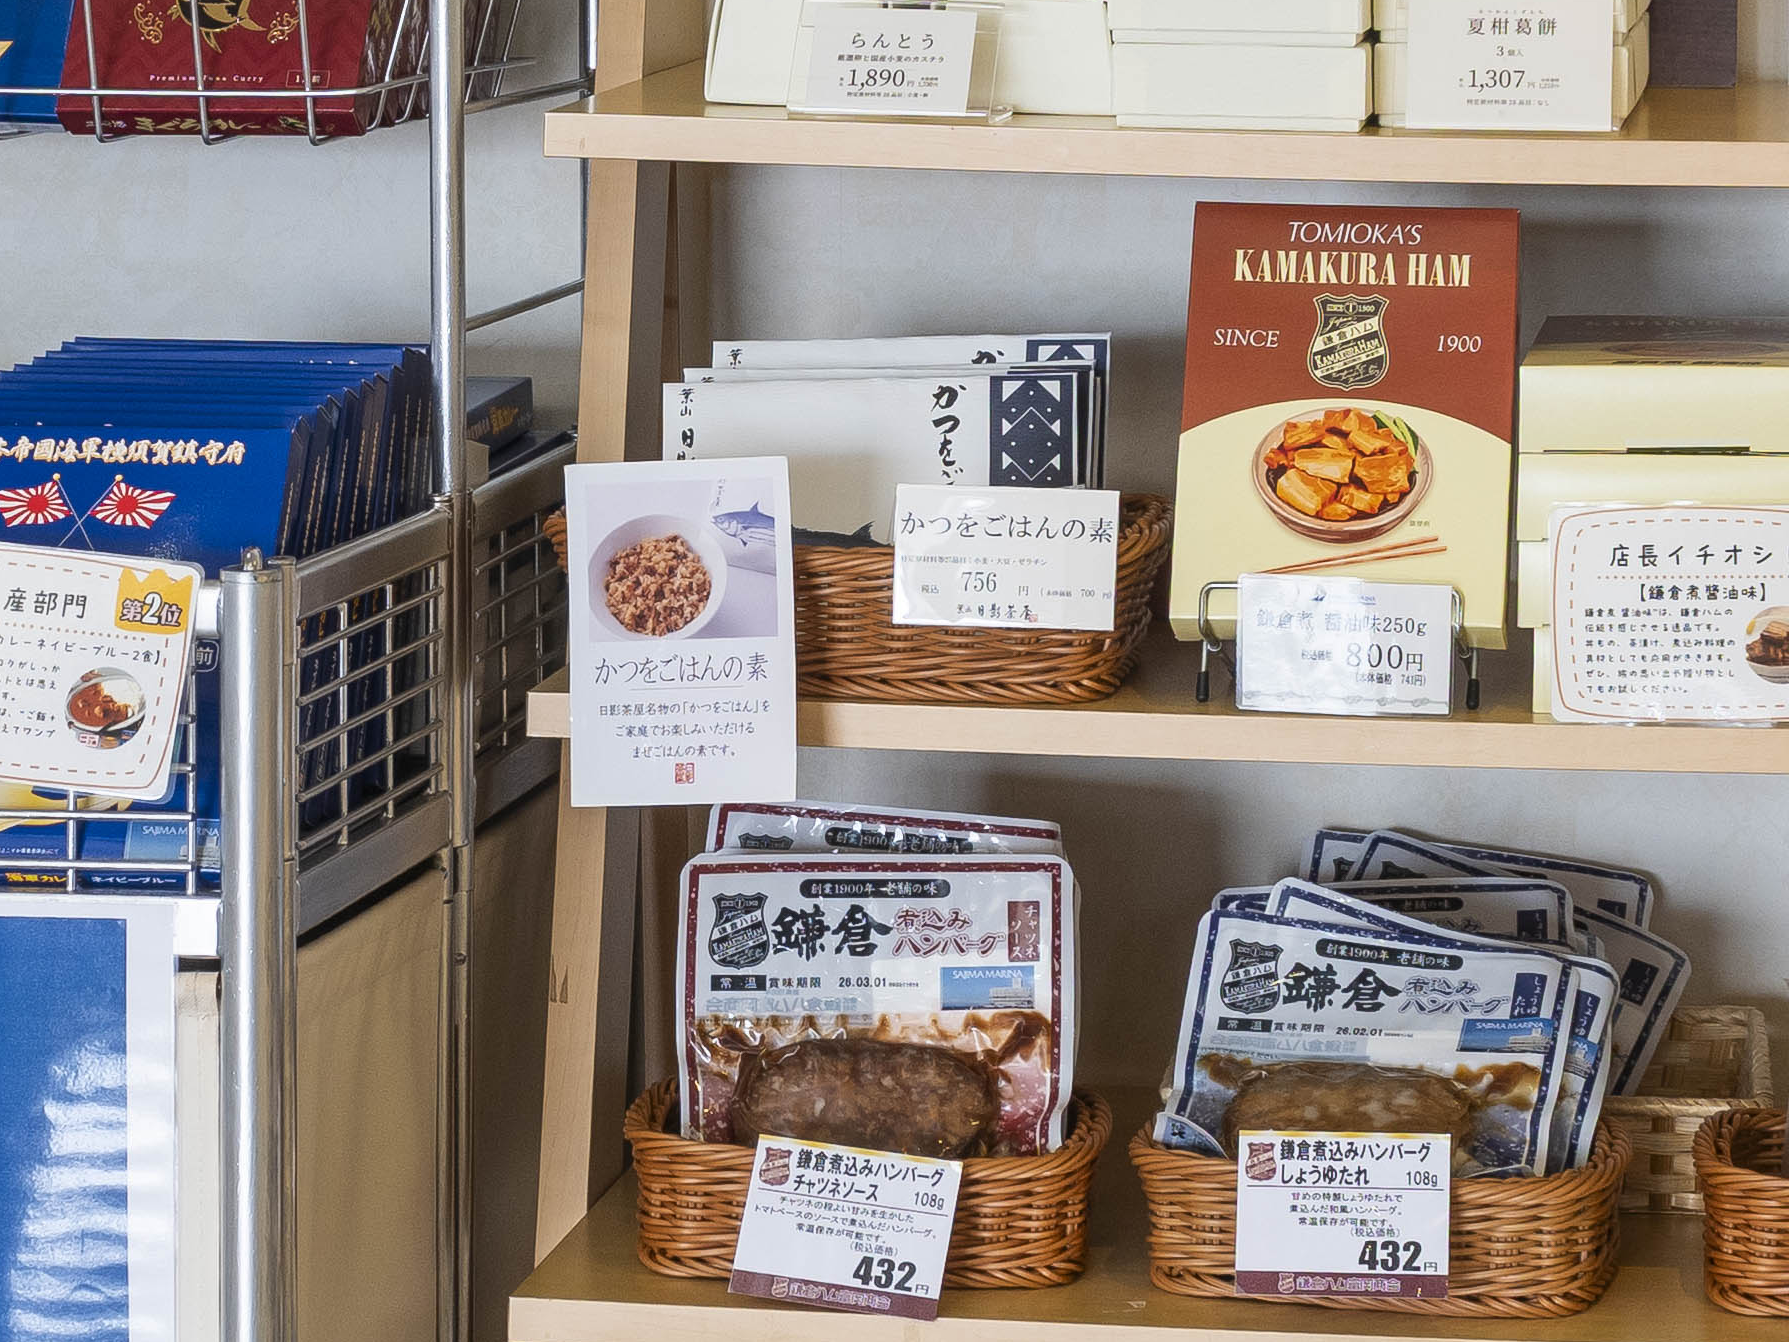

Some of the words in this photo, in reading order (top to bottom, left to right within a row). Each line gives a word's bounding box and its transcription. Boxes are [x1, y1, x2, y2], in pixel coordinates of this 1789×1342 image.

[1467, 18, 1557, 36] 夏柑葛餅
[852, 32, 934, 50] らんとう
[149, 74, 197, 83] Premium
[1288, 221, 1423, 245] TOMIOKA'S
[1234, 249, 1396, 286] KAMAKURA
[1406, 253, 1471, 288] HAM
[1213, 327, 1280, 349] SINCE
[1437, 333, 1482, 354] 1900
[900, 512, 1115, 545] かつをごはんの素
[960, 570, 997, 594] 756
[595, 651, 769, 683] かつをごはんの素
[599, 699, 770, 718] 日影茶屋名物の「かつをごはん」を
[615, 720, 755, 738] ご家庭でお楽しみいただける
[632, 742, 738, 758] まぜごはんの素です。
[771, 904, 892, 962] 鎌倉
[894, 908, 972, 932] 煮込み
[892, 933, 1004, 958] ハンバーグ
[1282, 962, 1402, 1014] 鎌倉
[1402, 975, 1479, 997] 煮込み
[1398, 995, 1510, 1018] ハンバーグ
[1280, 1139, 1431, 1162] 鎌倉煮込みハンバーグ
[796, 1148, 945, 1187] 鎌倉煮込みハンバーグ
[1281, 1165, 1370, 1186] しょうゆたれ
[1406, 1170, 1438, 1188] 108g
[793, 1174, 880, 1202] チャツネソース
[913, 1191, 945, 1211] 108g
